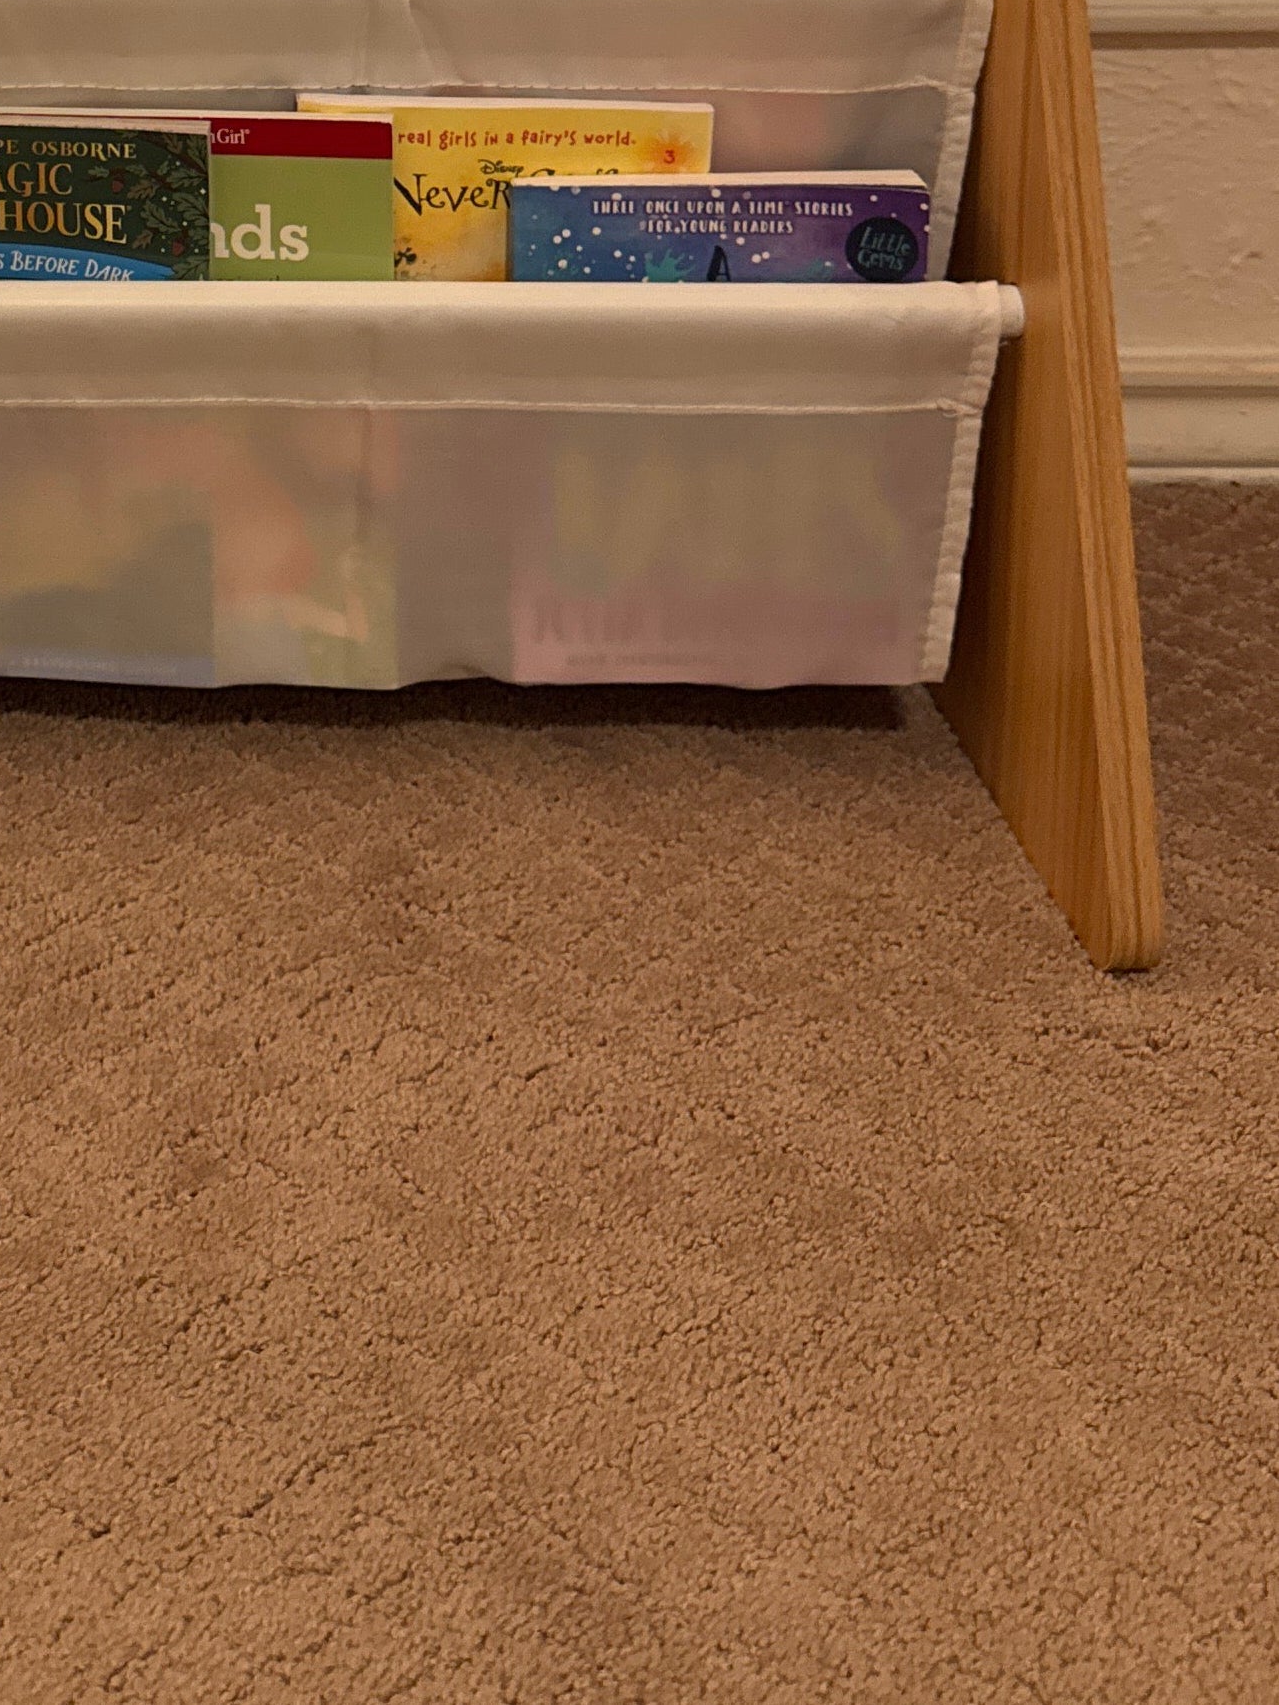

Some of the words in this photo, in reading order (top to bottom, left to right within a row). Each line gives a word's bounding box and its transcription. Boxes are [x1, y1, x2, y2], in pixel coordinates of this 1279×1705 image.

[397, 130, 431, 146] real
[439, 130, 477, 151] girls
[484, 130, 499, 146] in
[505, 133, 514, 145] a
[521, 130, 576, 146] fairy's
[584, 130, 636, 146] world.
[32, 141, 137, 161] OSBORNE
[663, 149, 675, 164] 3
[593, 200, 634, 214] THREE
[686, 200, 725, 214] UPON
[731, 201, 741, 214] A
[794, 201, 853, 216] STORIES
[679, 219, 727, 233] YOUNG
[733, 220, 794, 234] READERS
[10, 250, 81, 276] BEFORE
